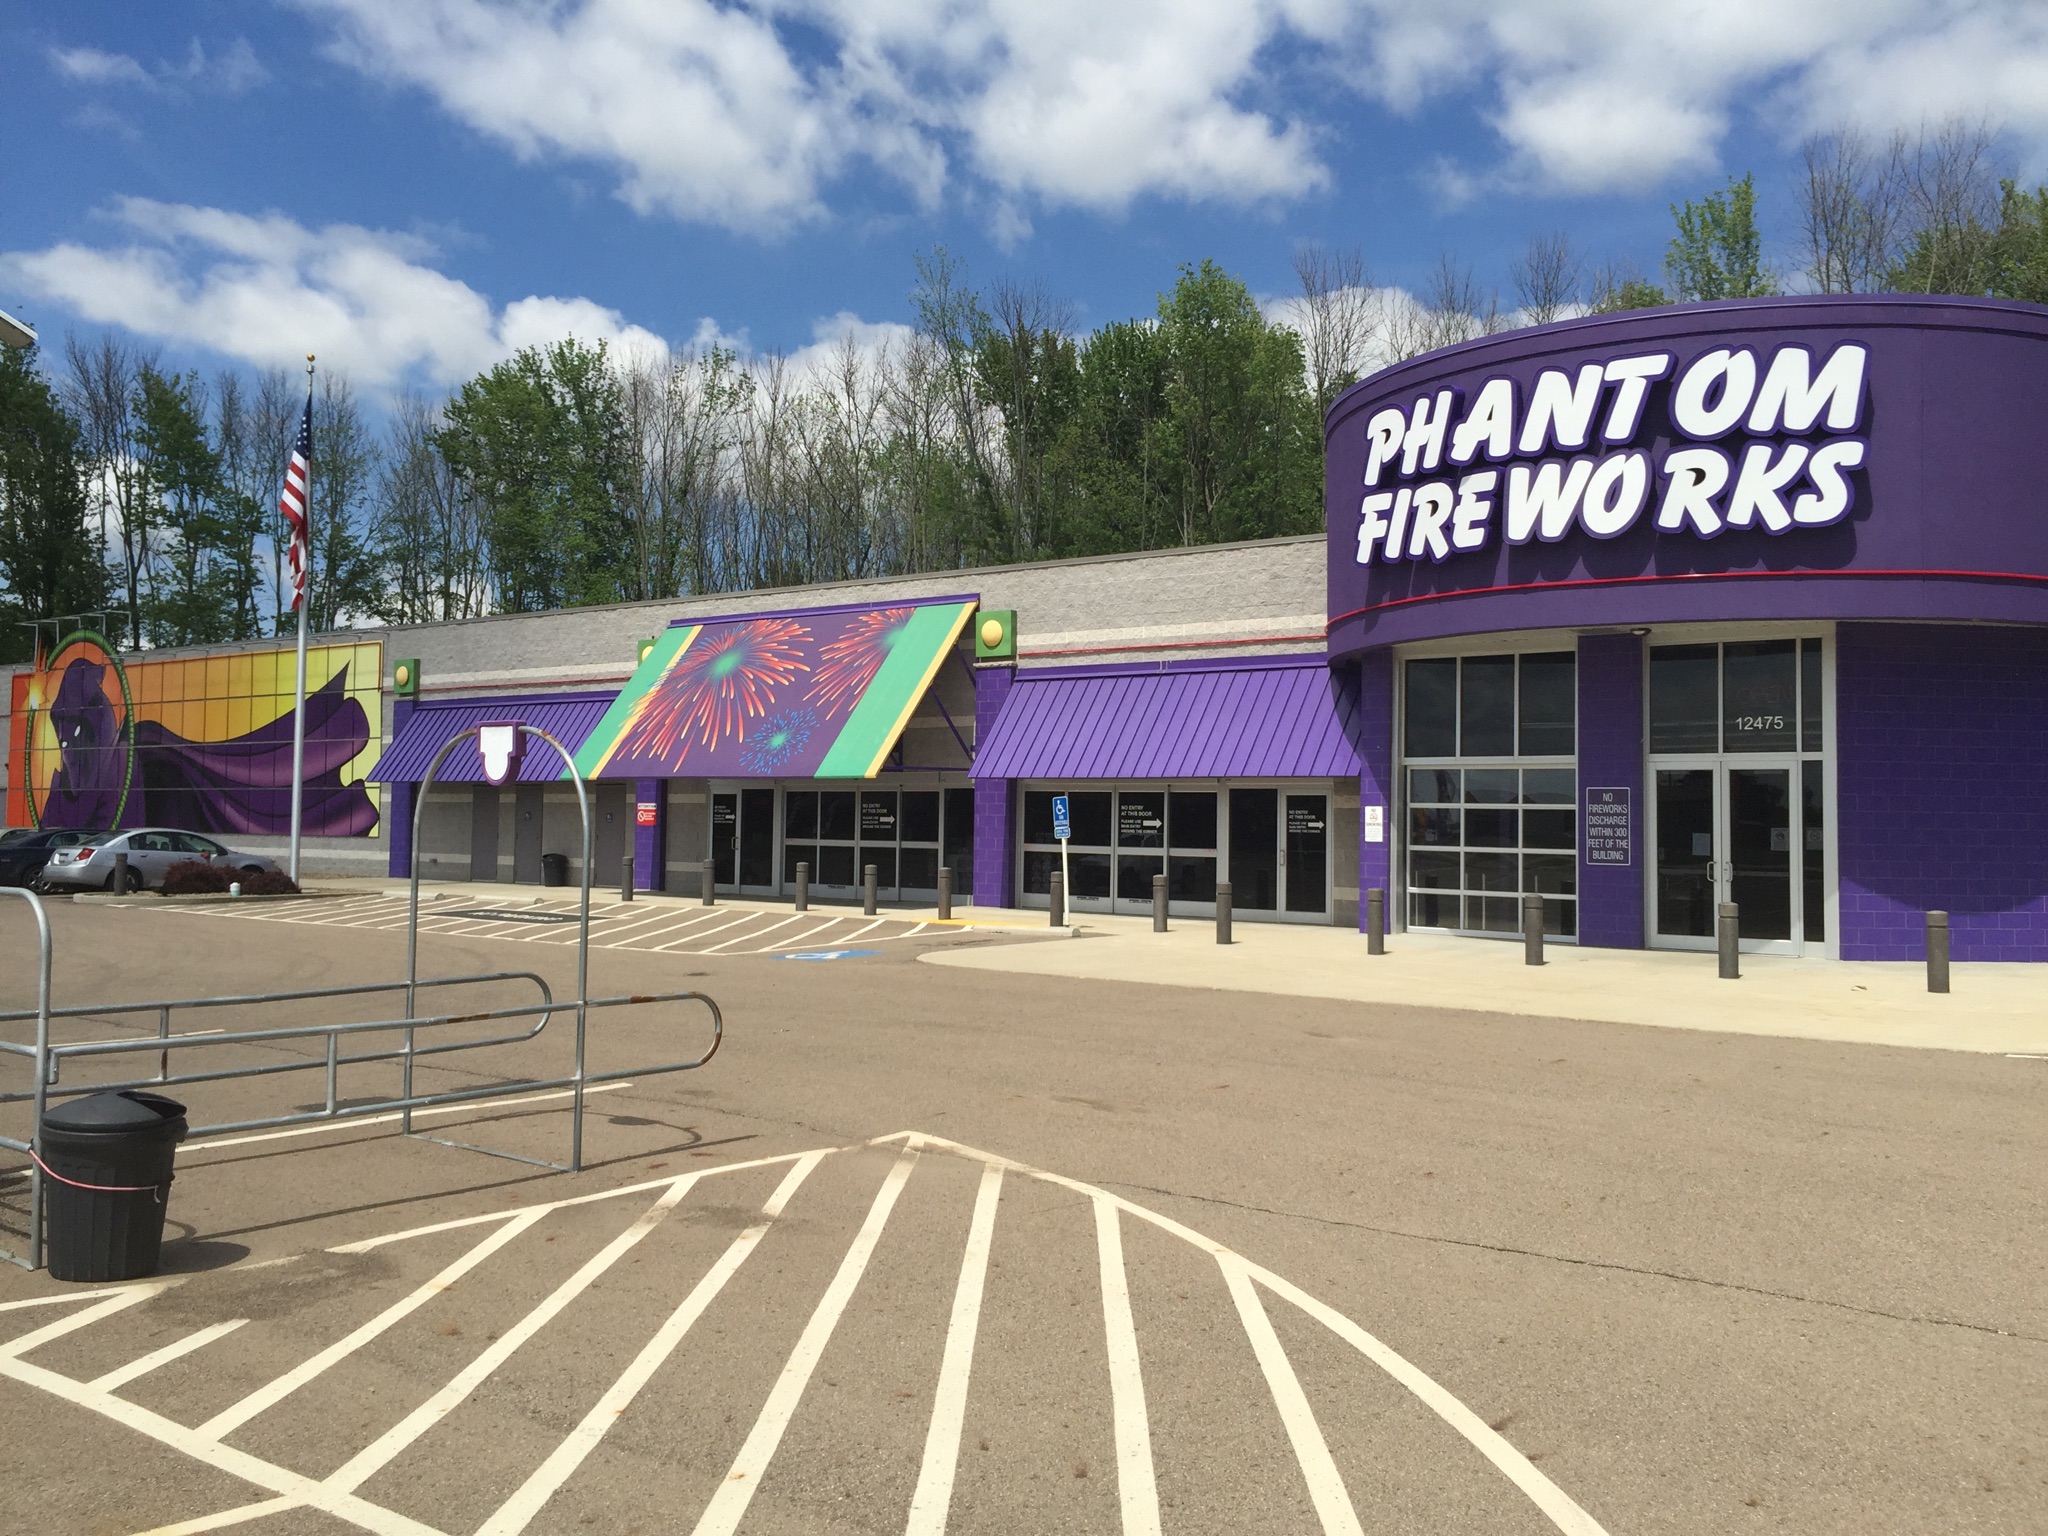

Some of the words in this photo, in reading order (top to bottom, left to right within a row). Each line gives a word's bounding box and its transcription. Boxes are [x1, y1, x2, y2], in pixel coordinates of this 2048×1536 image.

[1363, 344, 1866, 486] PHANTOM
[1356, 441, 1865, 565] FIREWORKS
[1735, 715, 1784, 730] 12475
[1602, 792, 1613, 802] NO
[1588, 804, 1628, 814] FIREWORKS
[1588, 815, 1628, 825] DISCHARGE
[1588, 827, 1613, 837] WITHIN
[1614, 827, 1627, 837] 300
[1588, 838, 1604, 848] FEET
[1605, 839, 1614, 848] OF
[1615, 839, 1629, 849] THE
[1592, 850, 1624, 860] BUILDING
